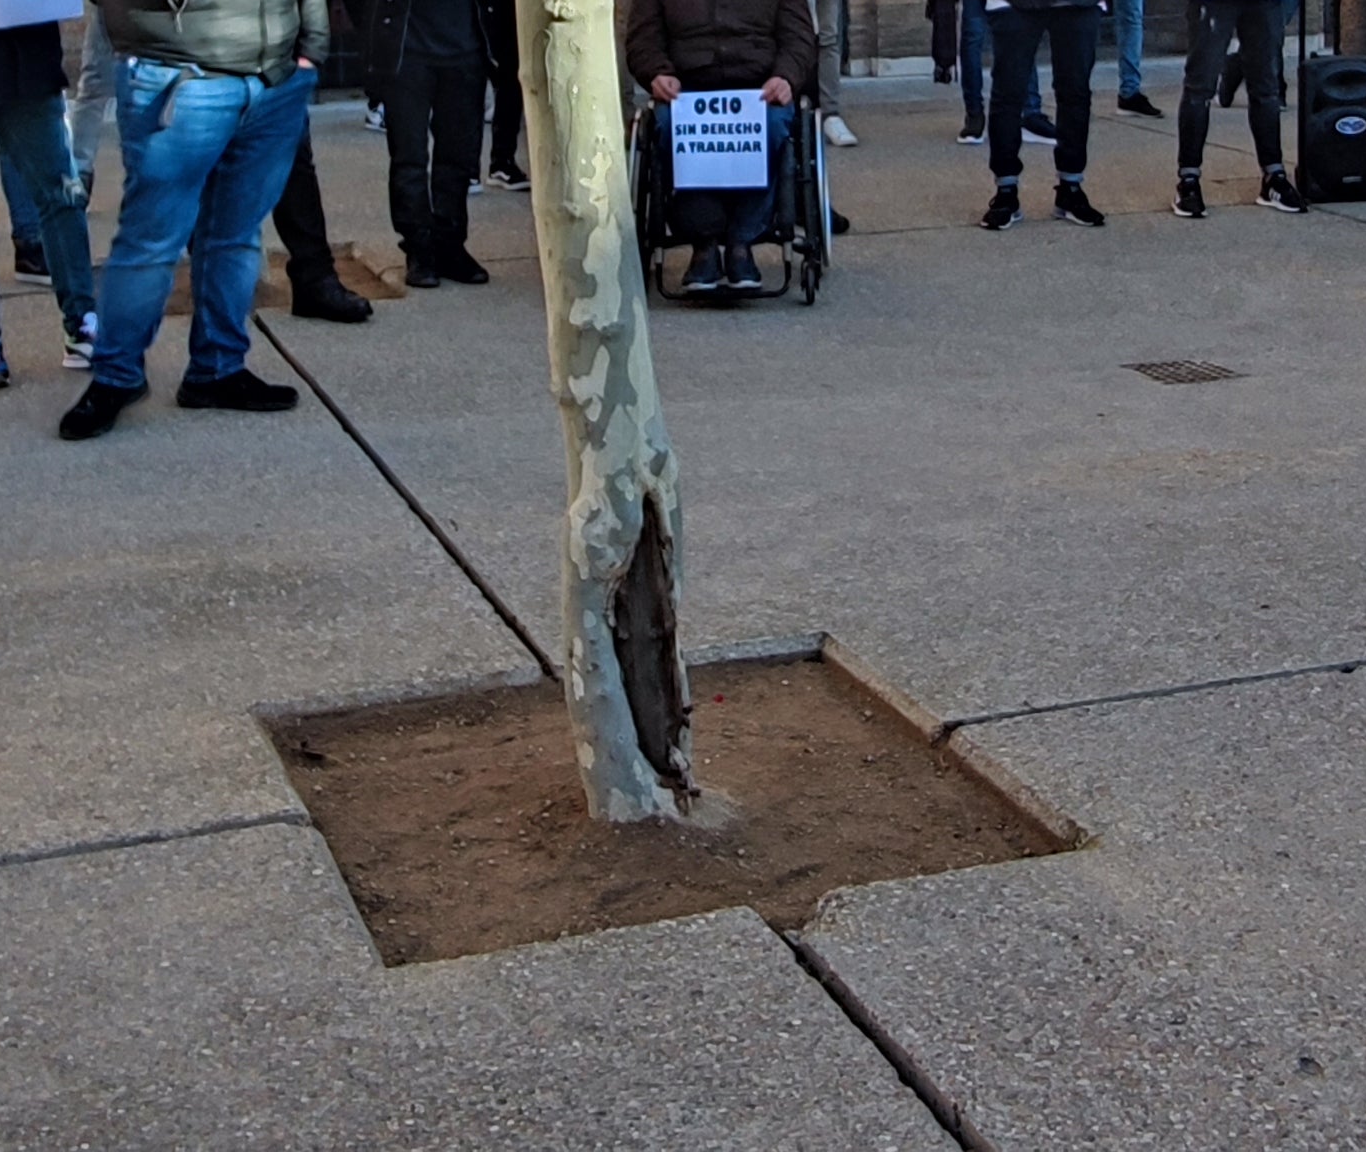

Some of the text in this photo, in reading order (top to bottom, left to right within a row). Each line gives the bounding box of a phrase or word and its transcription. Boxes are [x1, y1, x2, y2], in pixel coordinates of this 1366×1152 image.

[694, 96, 742, 115] OCIO
[675, 122, 762, 135] SIN DERECHO
[676, 140, 762, 154] A TRABAJAR
